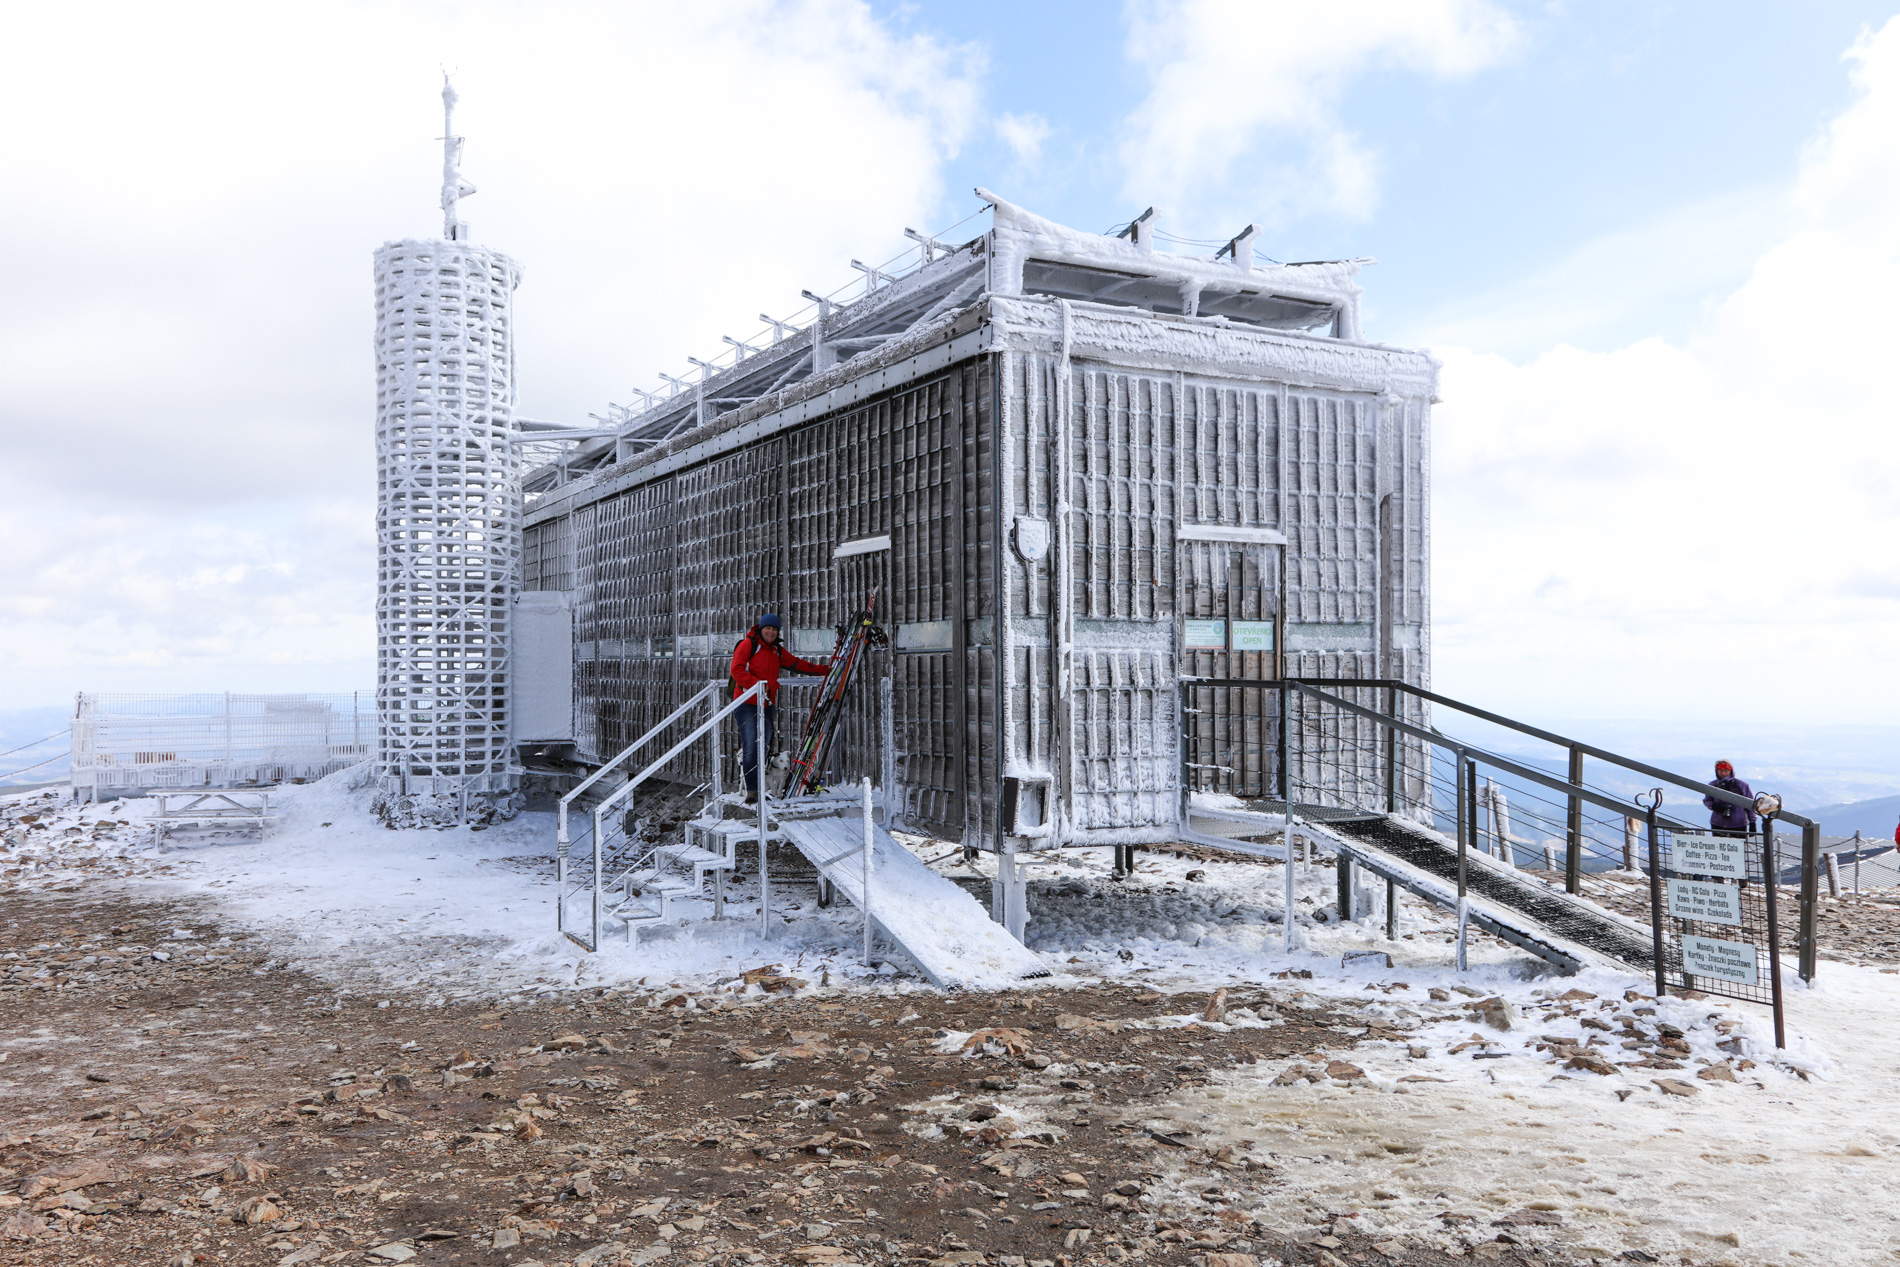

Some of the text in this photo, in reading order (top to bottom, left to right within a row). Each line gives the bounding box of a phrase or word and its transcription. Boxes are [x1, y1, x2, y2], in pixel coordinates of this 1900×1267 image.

[1233, 626, 1272, 635] OTEVŘENO
[1677, 839, 1687, 848] Bier
[1699, 842, 1715, 851] Cream
[1719, 843, 1726, 851] RC
[1727, 844, 1738, 852] Cola
[1685, 850, 1730, 861] Coffee Pizza Tea
[1710, 862, 1735, 872] Postcards
[1677, 885, 1726, 898] Lody RC Cola Pizza
[1677, 895, 1729, 908] Kawa Piwo Herbata
[1675, 903, 1732, 918] Grzane wino Czekolada
[1696, 942, 1741, 958] Monety Magnesy
[1708, 954, 1726, 964] Znaczki
[1727, 958, 1751, 969] pocztowe
[1714, 965, 1745, 978] turystyczny
